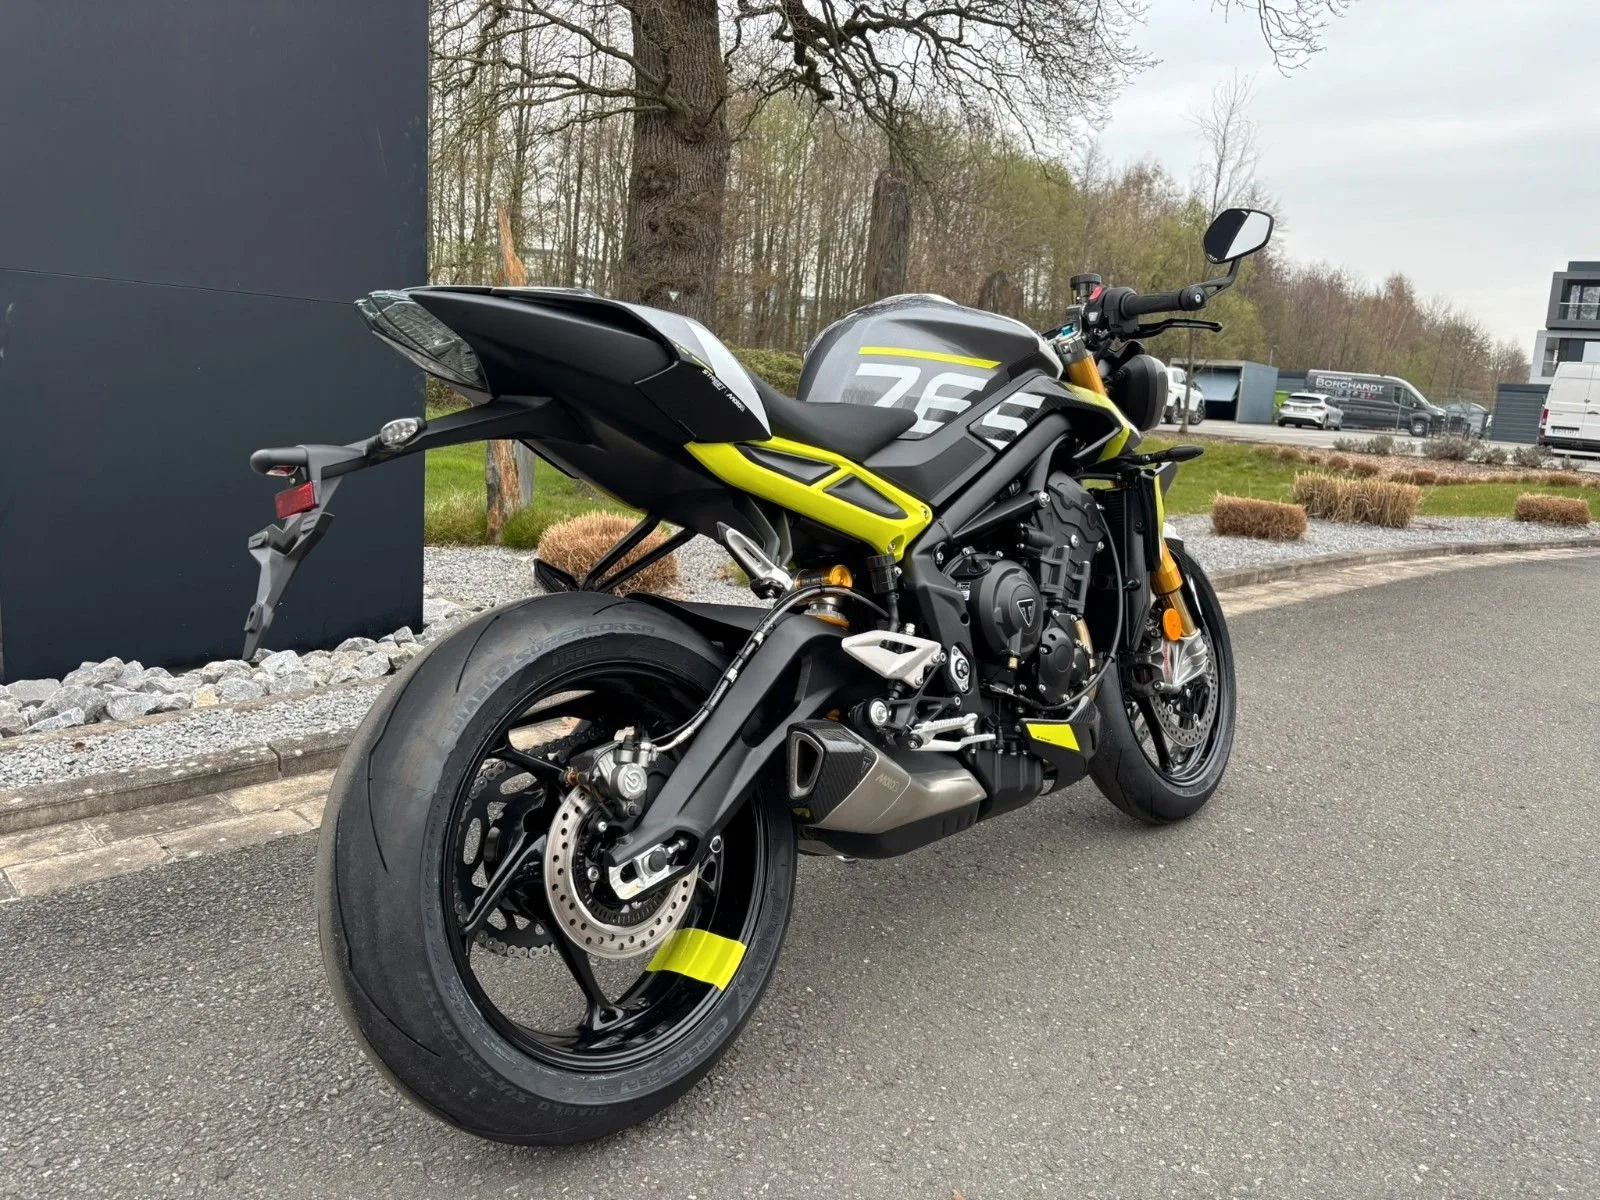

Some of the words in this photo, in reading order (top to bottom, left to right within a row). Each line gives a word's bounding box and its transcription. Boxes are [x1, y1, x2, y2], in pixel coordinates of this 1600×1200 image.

[701, 368, 726, 391] STREET
[1315, 377, 1385, 392] BORCHARDT
[513, 621, 657, 666] SUPERCORSA
[627, 1021, 725, 1090] SUPERCORSA
